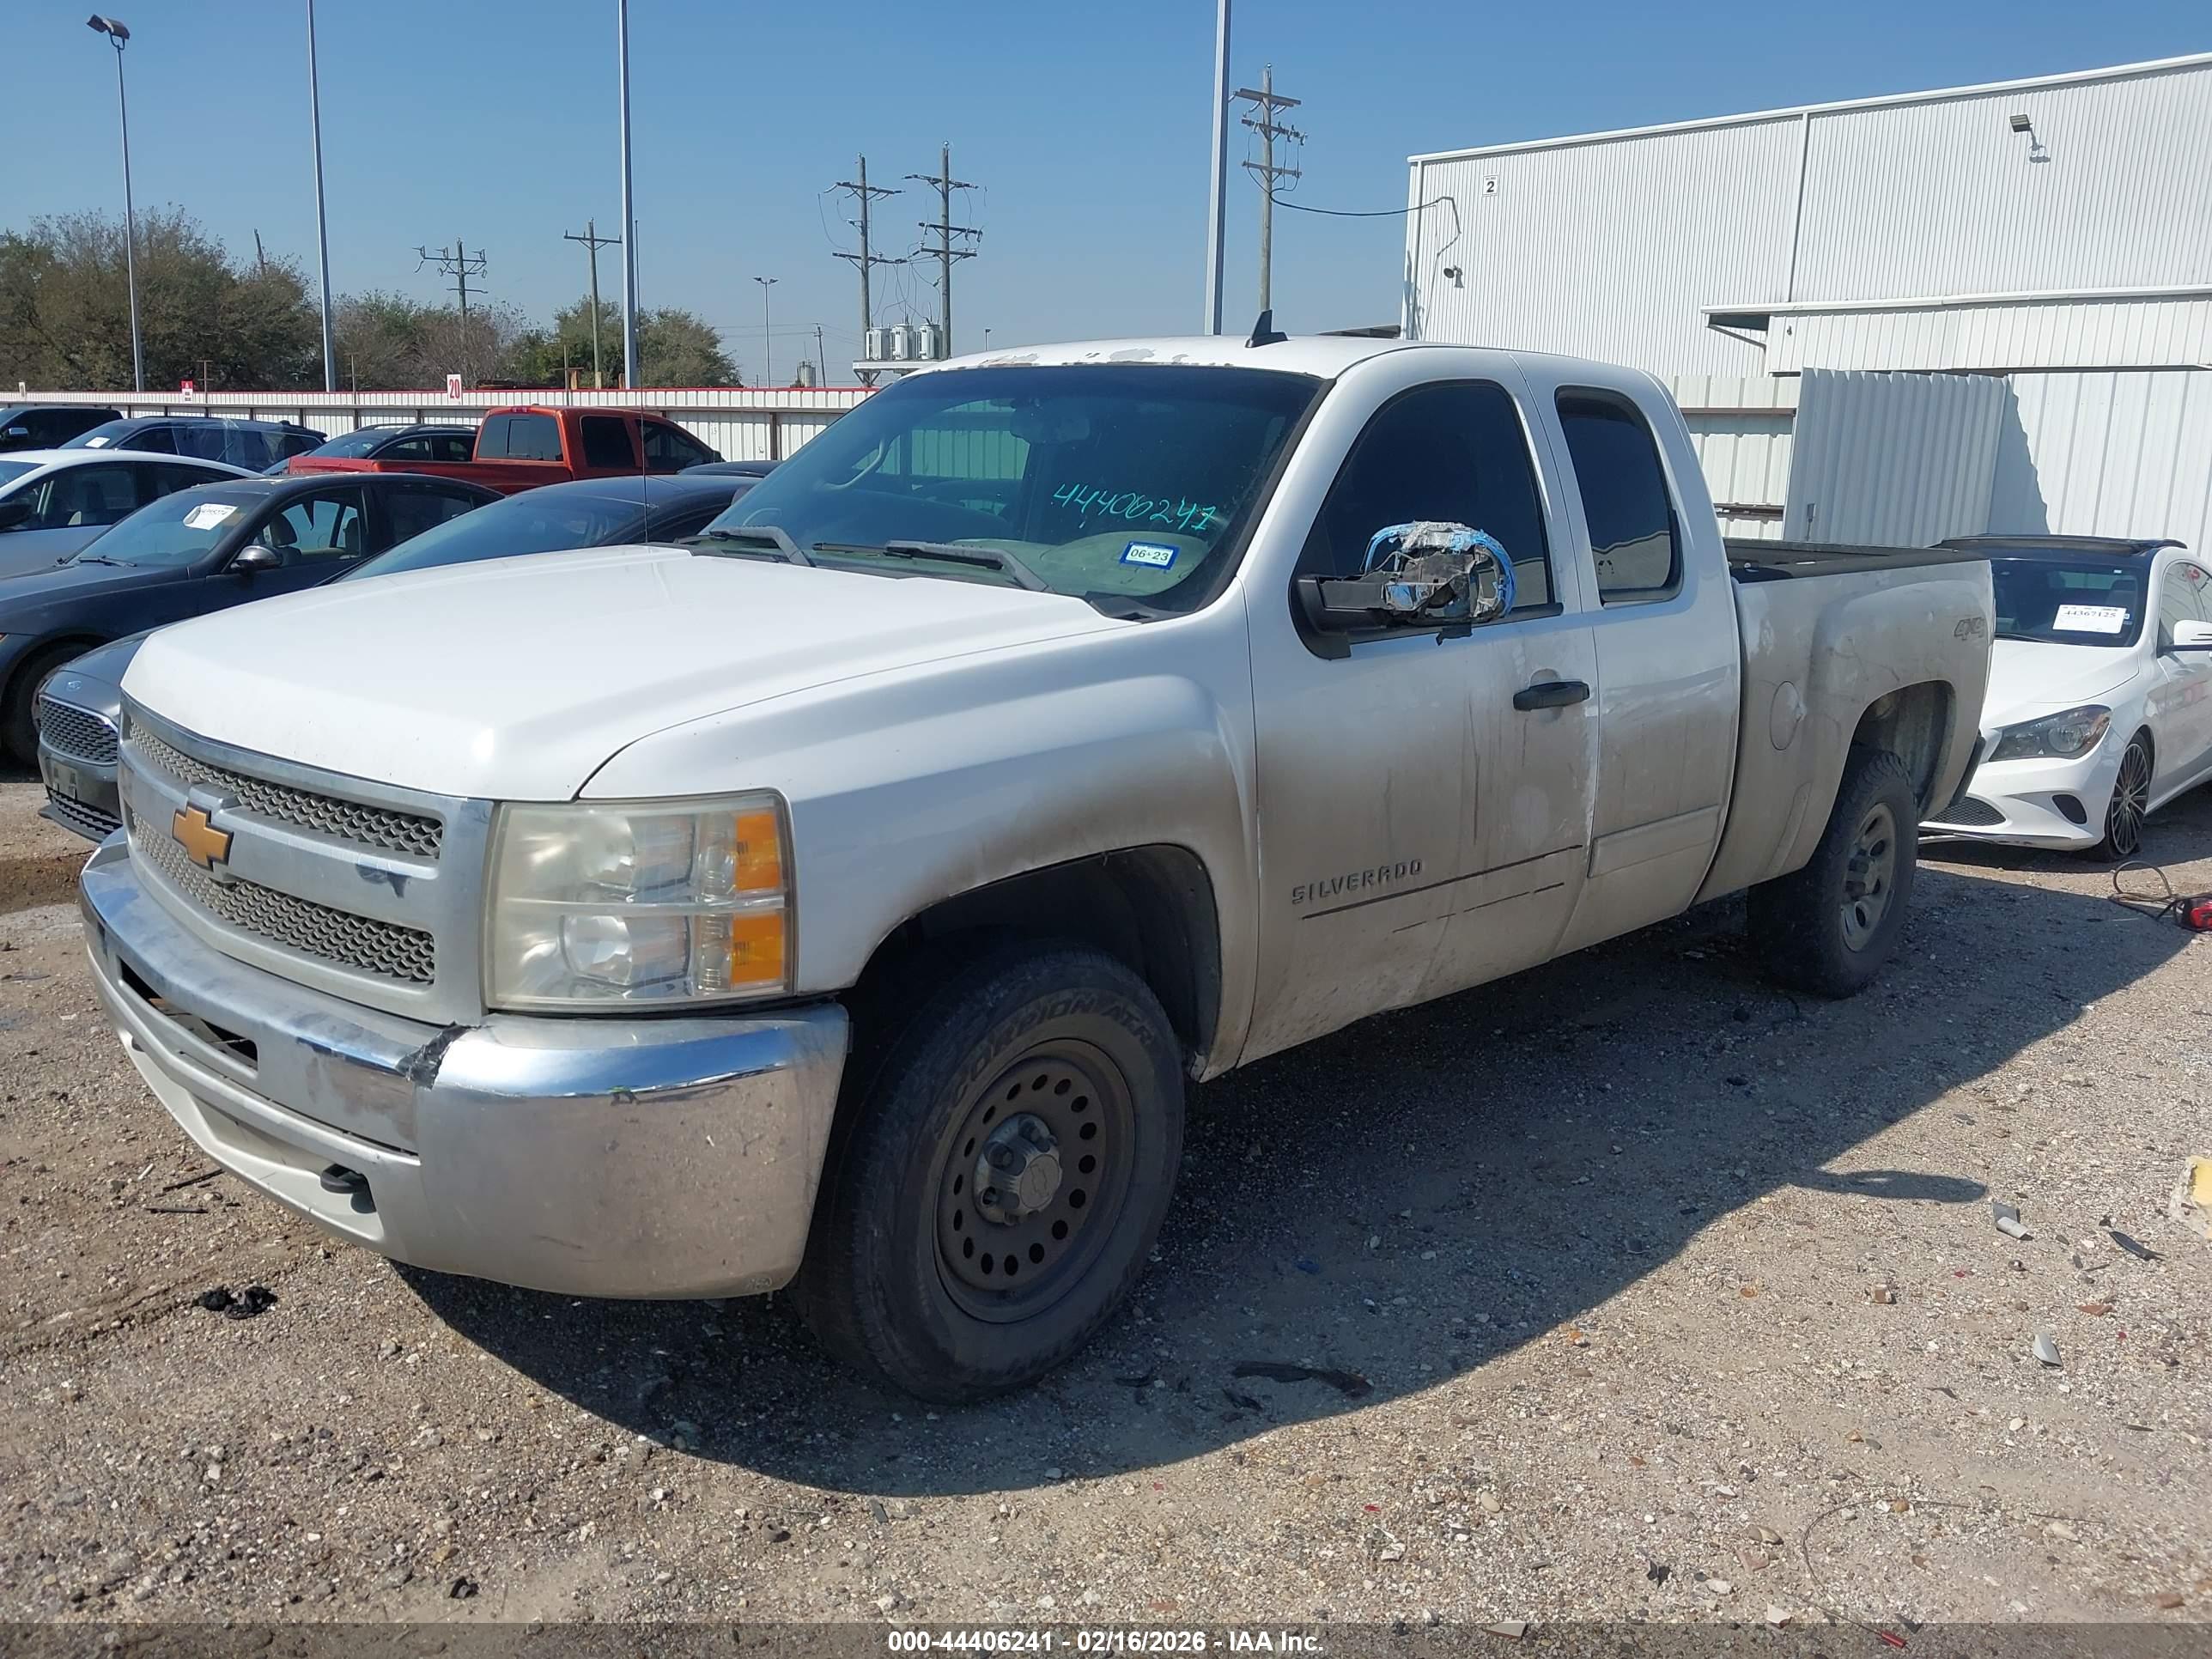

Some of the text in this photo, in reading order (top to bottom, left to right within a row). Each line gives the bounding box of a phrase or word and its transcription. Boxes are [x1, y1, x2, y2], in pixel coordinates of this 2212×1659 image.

[1486, 180, 1495, 193] 2
[449, 379, 460, 399] 20
[1130, 549, 1169, 561] 06 23
[1291, 859, 1422, 905] SILVERADO
